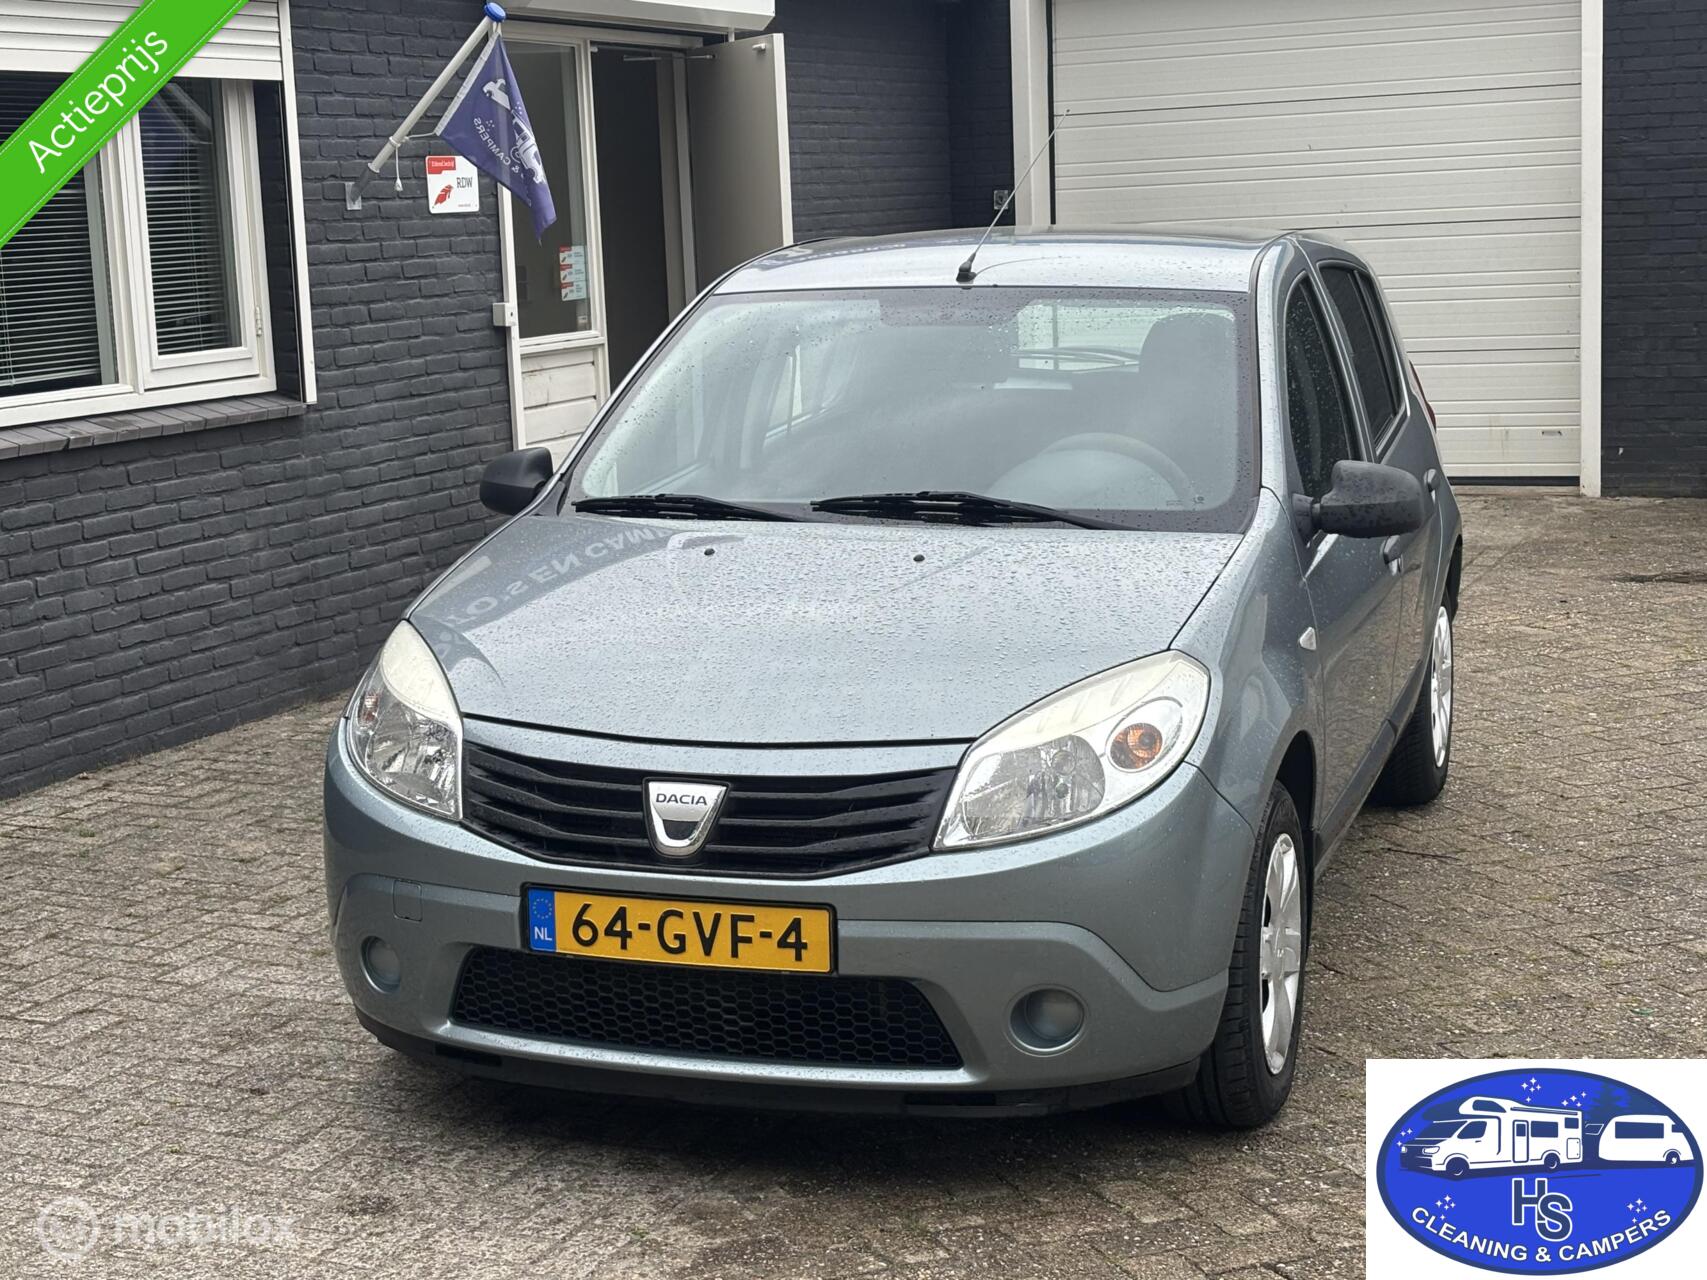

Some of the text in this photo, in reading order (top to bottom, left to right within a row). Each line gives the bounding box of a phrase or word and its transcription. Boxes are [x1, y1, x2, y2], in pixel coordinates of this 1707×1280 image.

[456, 177, 473, 189] RDW
[655, 793, 708, 806] DACIA
[534, 926, 553, 942] NL
[571, 903, 808, 962] 64-GVF-4
